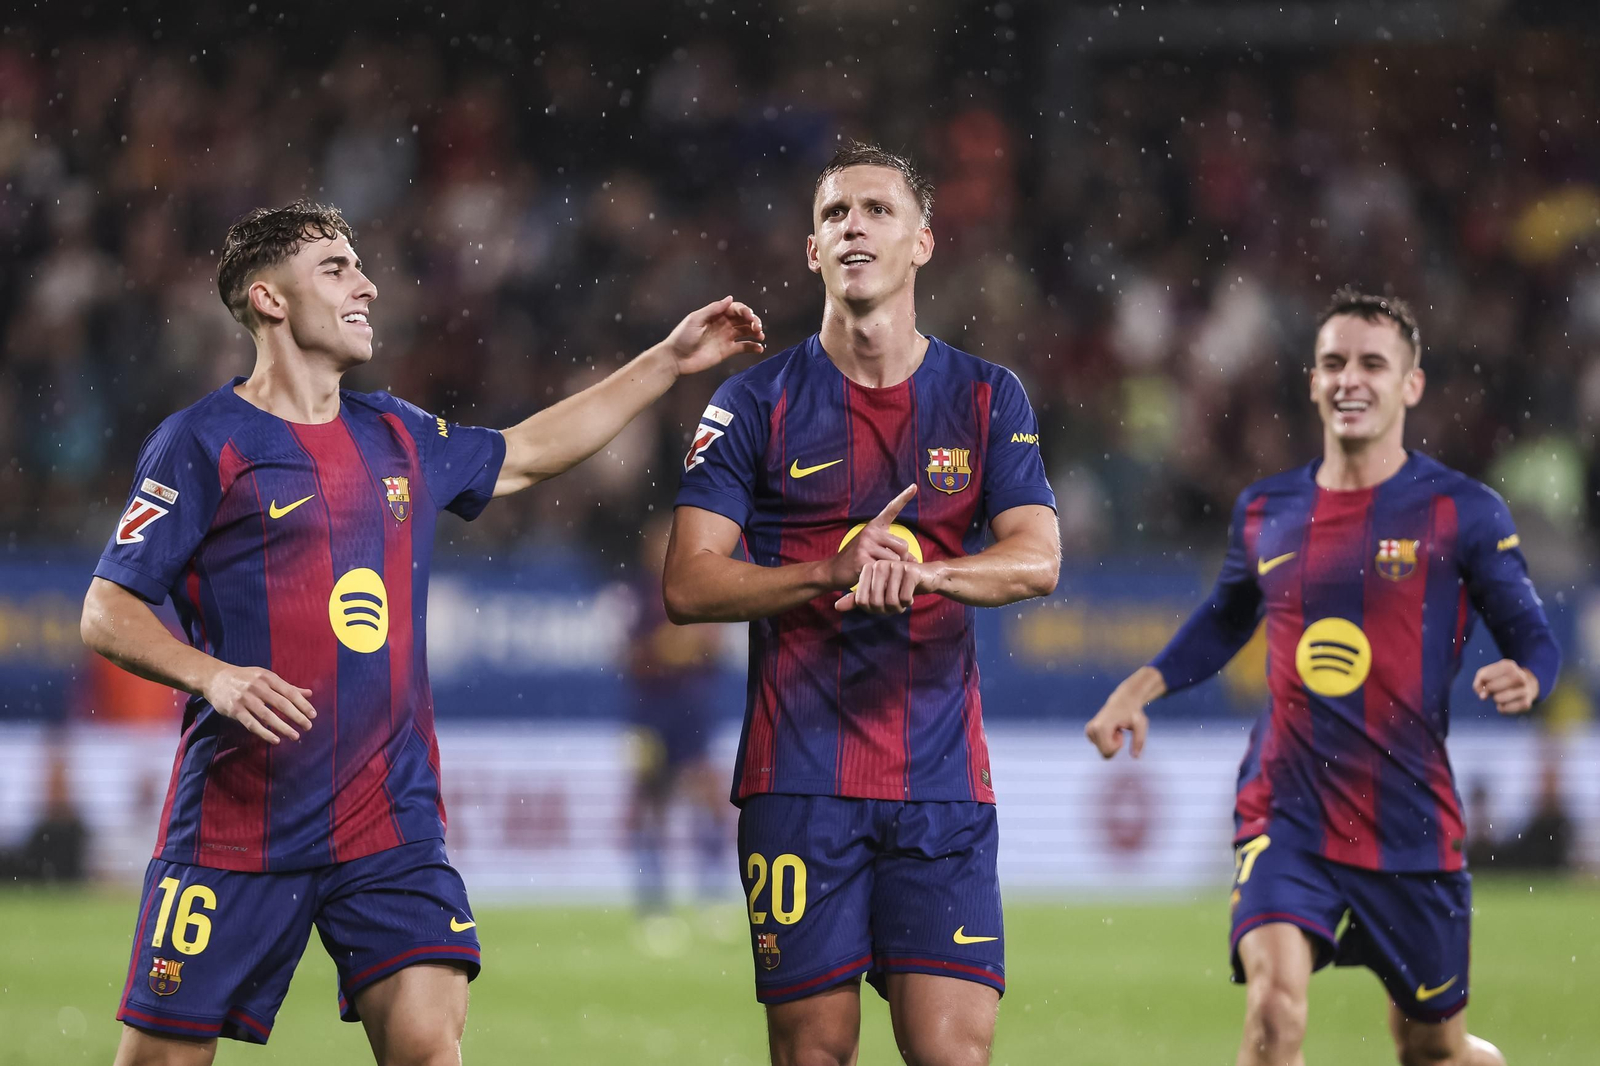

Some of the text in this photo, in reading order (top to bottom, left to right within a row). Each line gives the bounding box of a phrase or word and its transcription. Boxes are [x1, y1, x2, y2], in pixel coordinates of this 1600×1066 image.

[747, 853, 807, 925] 20
[1234, 834, 1271, 885] 7
[151, 876, 217, 956] 16
